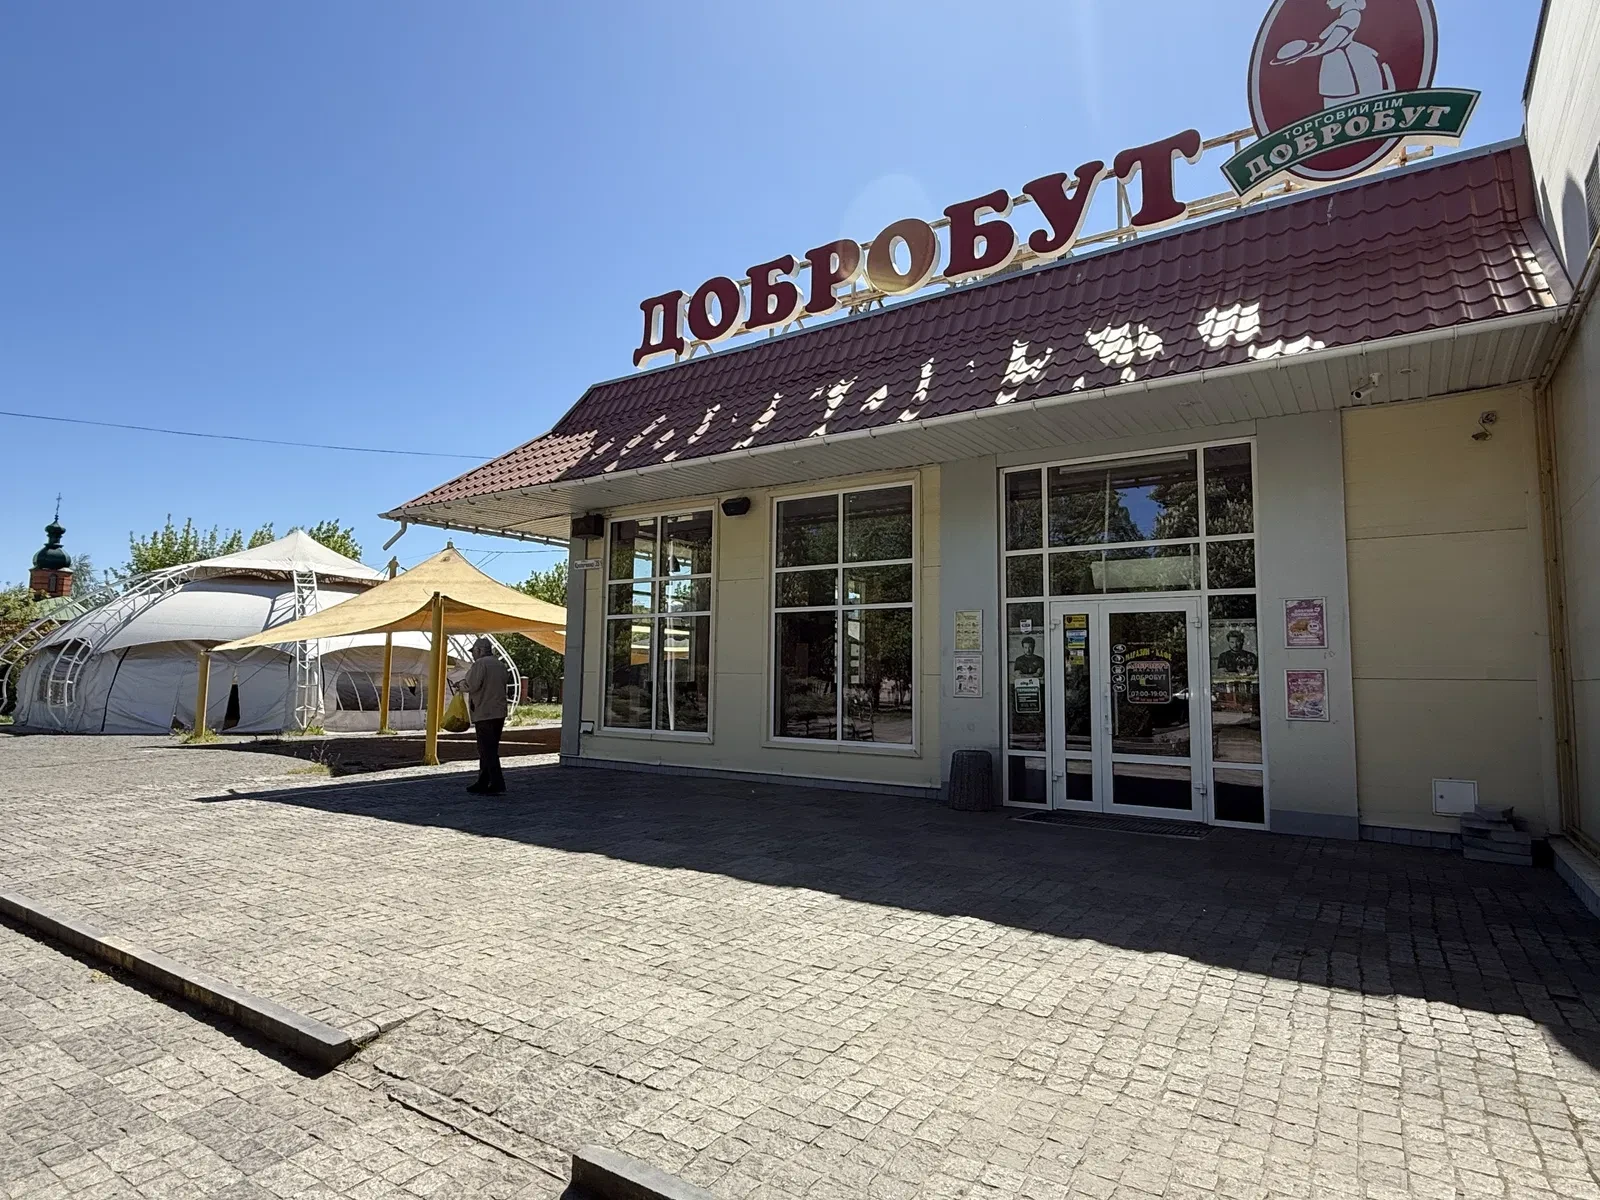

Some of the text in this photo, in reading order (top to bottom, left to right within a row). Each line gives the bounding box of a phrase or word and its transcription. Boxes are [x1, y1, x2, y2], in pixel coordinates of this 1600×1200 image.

[1245, 105, 1451, 182] ДОБРОБУТ
[1283, 97, 1403, 140] ТОРГОВИЙ ДІМ
[632, 128, 1203, 369] ДОБРОБУТ
[1155, 649, 1173, 661] КАФЕ
